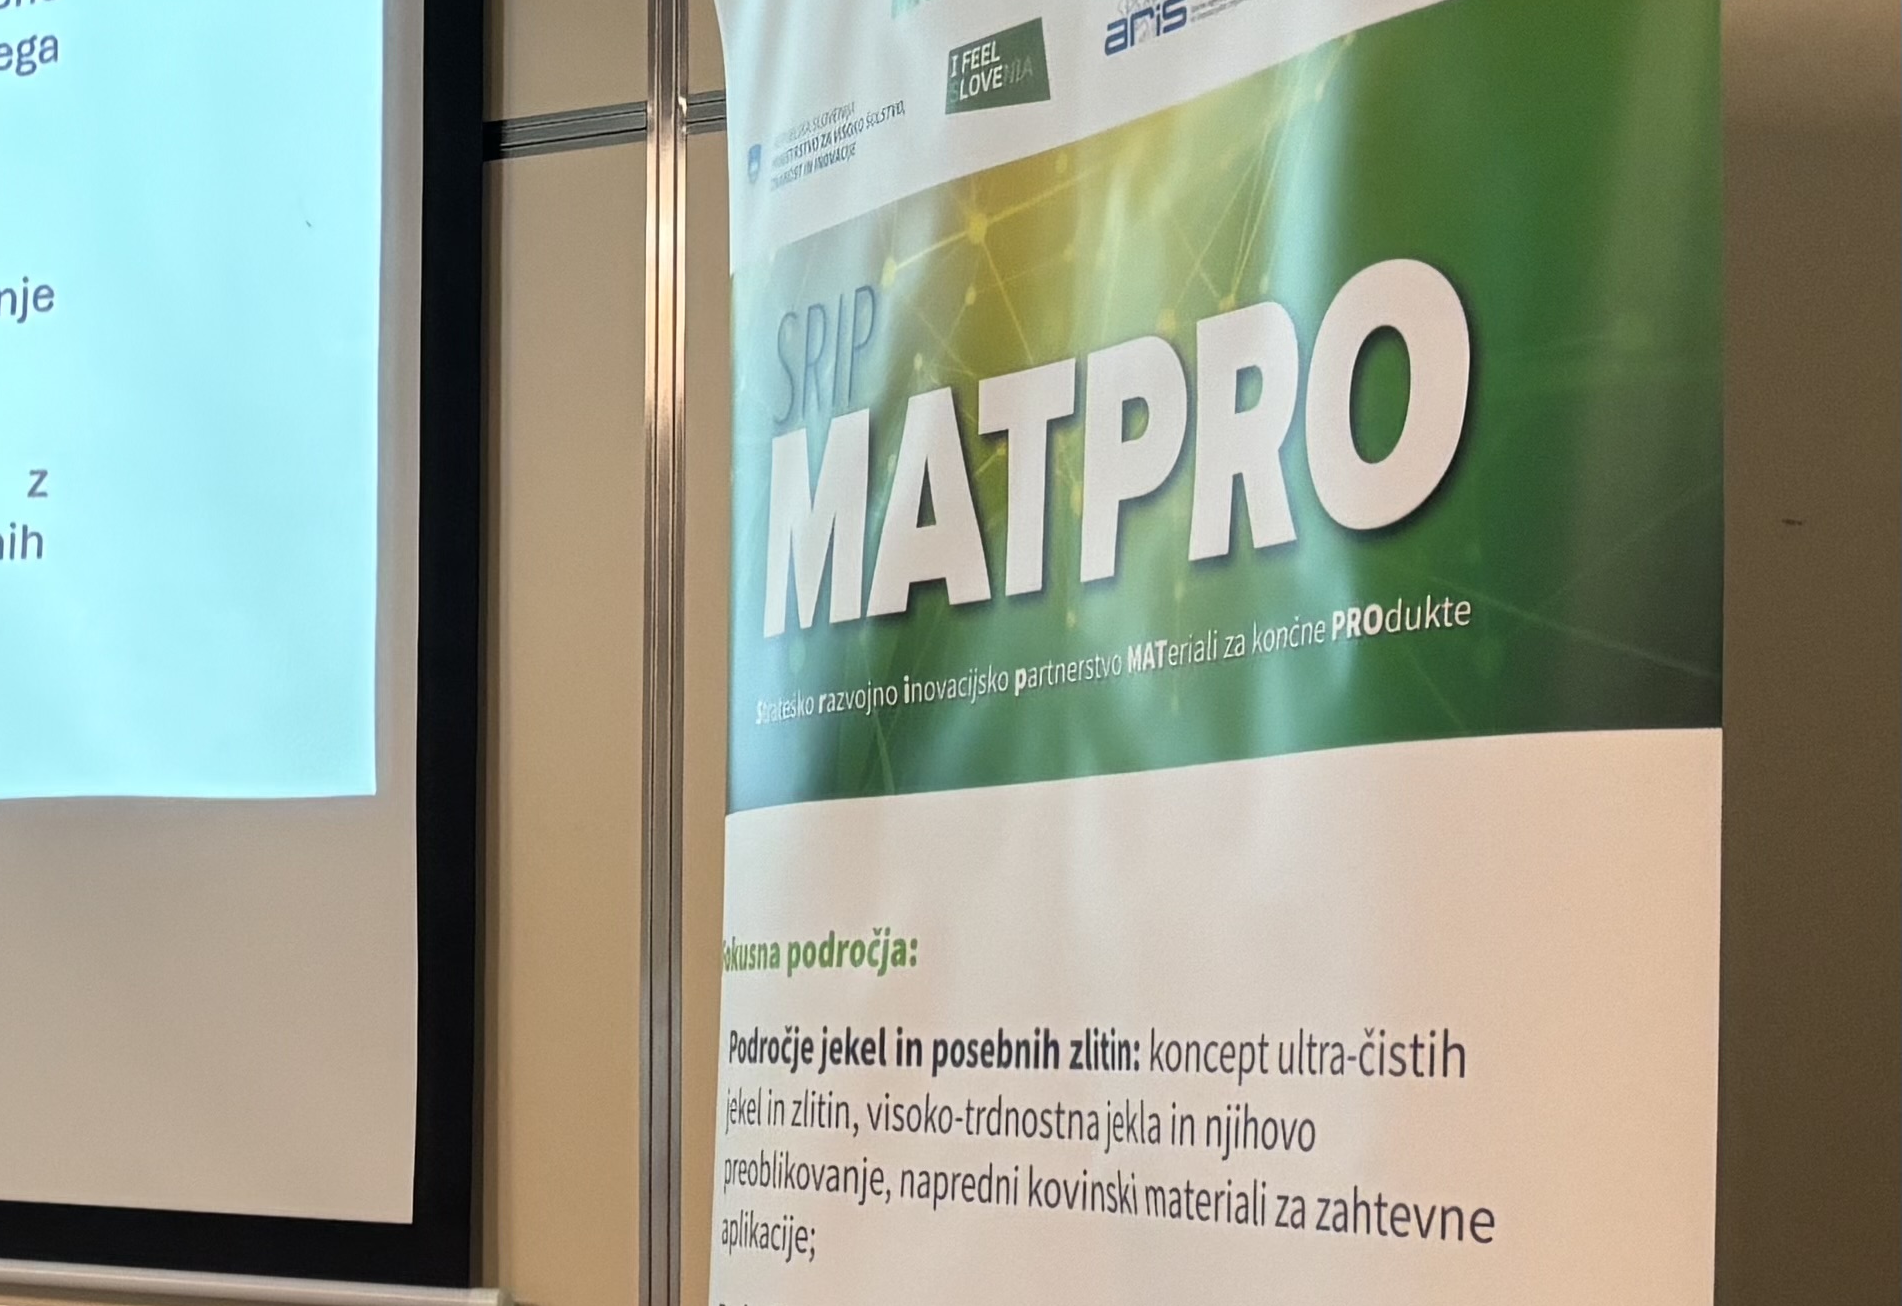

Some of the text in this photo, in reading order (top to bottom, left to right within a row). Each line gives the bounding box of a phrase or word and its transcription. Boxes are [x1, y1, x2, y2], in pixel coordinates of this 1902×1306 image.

[950, 40, 1001, 78] I FEEL
[774, 284, 878, 426] SRIP
[27, 470, 48, 497] z
[762, 257, 1471, 638] MATPRO
[819, 681, 898, 715] razvojno
[904, 665, 1008, 704] inovacijsko
[1015, 654, 1122, 696] partnerstvo
[1127, 630, 1217, 673] MATeriali
[1223, 634, 1245, 658] za
[1252, 616, 1326, 655] končne
[1332, 595, 1471, 640] PROdukte
[787, 927, 917, 977] področja:
[729, 1026, 1465, 1086] Področje jekel in posebnih zlitin: koncept ultra-čistih
[726, 1087, 1315, 1161] jekel in zlitin, visoko-trdnostna jekla in njihovo
[724, 1150, 1495, 1243] preoblikovanje, napredni kovinski materiali za zahtevne
